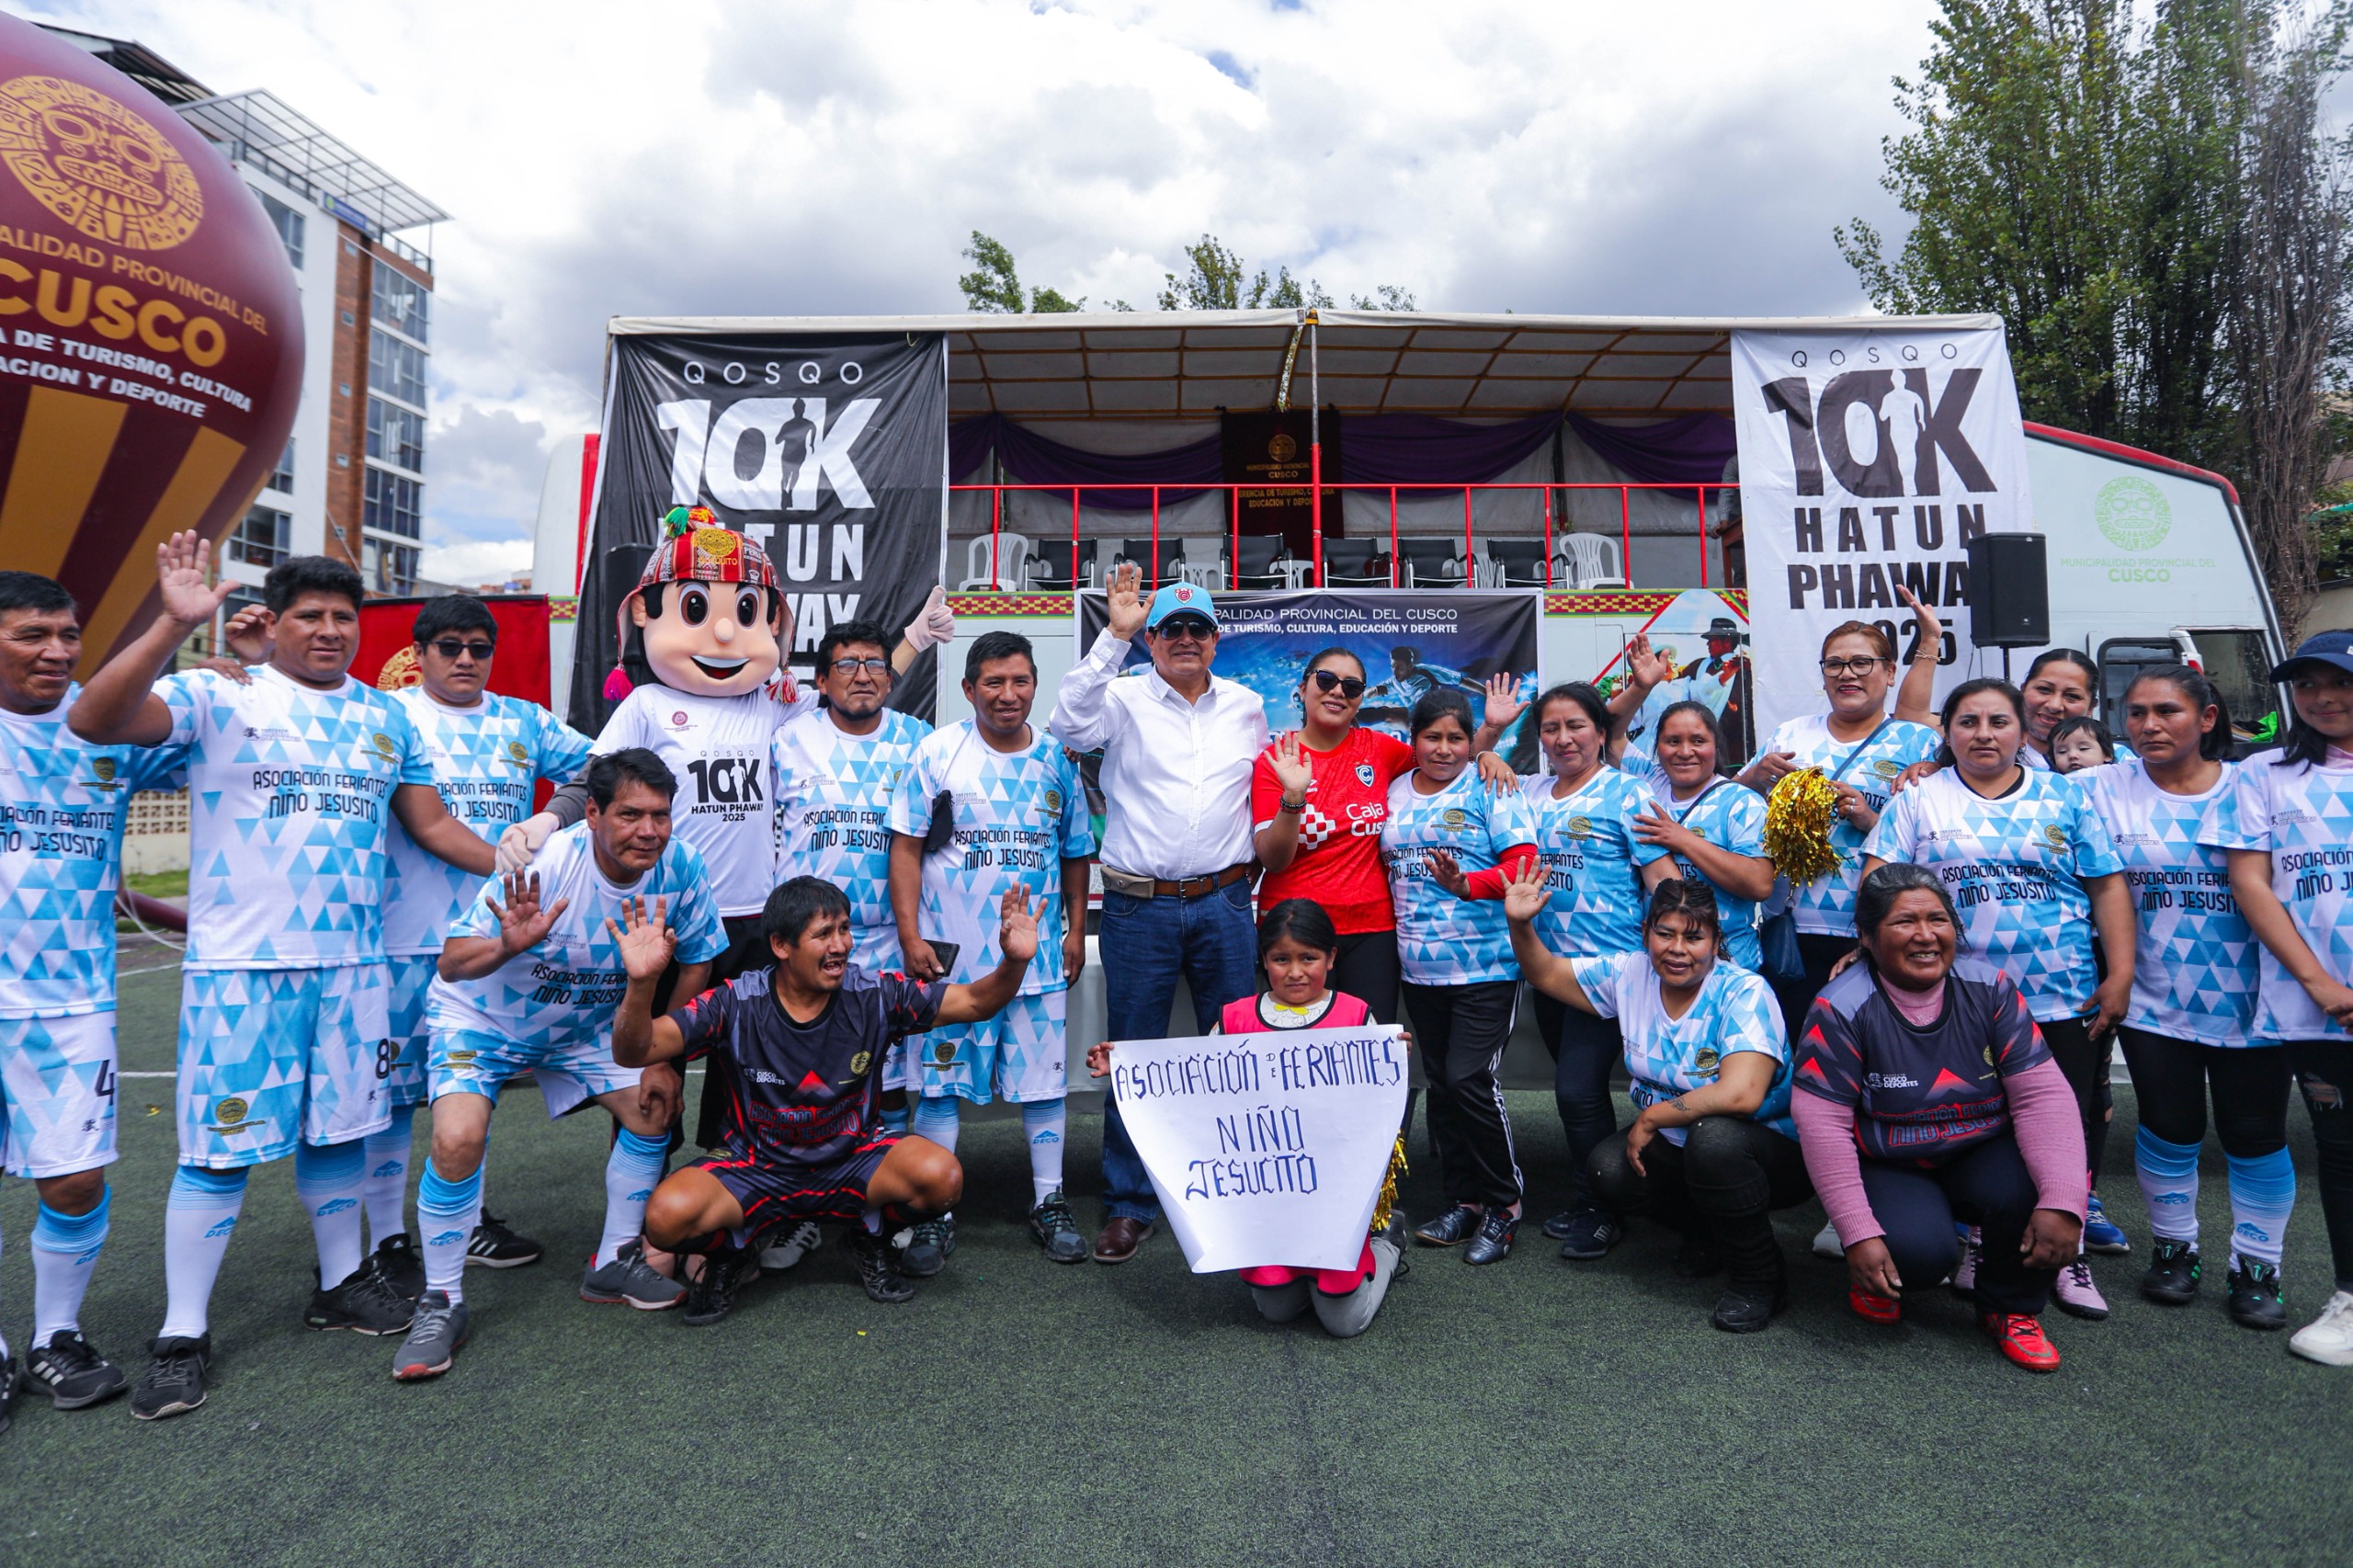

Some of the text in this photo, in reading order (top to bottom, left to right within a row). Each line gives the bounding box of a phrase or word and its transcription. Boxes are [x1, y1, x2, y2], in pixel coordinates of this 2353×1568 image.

[112, 254, 239, 319] PROVINCIAL
[243, 306, 268, 336] DEL
[0, 257, 226, 368] CUSCO
[1792, 344, 1957, 368] QOSQO
[15, 329, 252, 413] DE TURISMO, CULTURA
[684, 360, 863, 385] QOSQO
[86, 372, 108, 390] Y
[109, 379, 207, 418] DEPORTE
[1761, 368, 1998, 498] 10K
[656, 397, 882, 511] 10K
[1239, 489, 1265, 497] ERENCIA
[1267, 488, 1275, 496] DE
[1287, 498, 1292, 506] Y
[1794, 504, 1986, 552] HATUN
[2061, 558, 2216, 567] MUNICIPALIDAD PROVINCIAL DEL
[1788, 562, 1970, 609] PHAWA
[2108, 568, 2171, 583] CUSCO
[1279, 608, 1368, 620] PROVINCIAL
[1372, 608, 1402, 620] DEL
[1406, 608, 1458, 620] CUSCO
[1219, 621, 1458, 635] DE TURISMO, CULTURA, EDUCACIÓN Y DEPORTE
[1872, 619, 1957, 665] 025
[253, 770, 388, 800] ASOCIACIÓN FERIANTES
[687, 758, 764, 803] 10K
[479, 782, 527, 802] FERIANTES
[269, 789, 378, 824] NIÑO JESUSITO
[464, 801, 520, 824] JESUSITO
[691, 803, 764, 814] HATUN PHAWAY
[722, 813, 745, 822] 2025
[1346, 802, 1384, 820] Caja
[803, 808, 857, 828] ASOCIACIÓN
[29, 831, 106, 861] JESUSITO
[811, 826, 892, 853] NIÑO JESUSIT
[955, 827, 1051, 848] ASOCIACIÓN FERIANTES
[965, 846, 1046, 871] NIÑO JESUSITO
[1540, 853, 1584, 869] FERIANTES
[1942, 862, 2005, 883] ASOCIACIÓN
[1959, 881, 2056, 908] NIÑO JESUSITO
[2296, 869, 2334, 902] NIÑO
[2143, 888, 2173, 912] NIÑO
[531, 963, 600, 985] ASOCIACIÓN
[532, 984, 572, 1005] NIÑO
[376, 1039, 390, 1079] 8
[1280, 1036, 1401, 1091] FERIANTES
[95, 1060, 115, 1106] 4
[756, 1071, 777, 1079] CUSCO
[756, 1077, 786, 1085] DEPORTES
[1883, 1076, 1907, 1085] CUSCO
[1883, 1080, 1919, 1088] DEPORTES
[1032, 1136, 1060, 1144] DECO
[1216, 1105, 1305, 1154] NIÑO
[372, 1167, 404, 1177] DECO
[1186, 1153, 1318, 1201] JESUCITO
[316, 1199, 358, 1217] DECO
[2154, 1197, 2189, 1205] DECO
[429, 1233, 464, 1246] DECO
[2236, 1227, 2269, 1242] DECO
